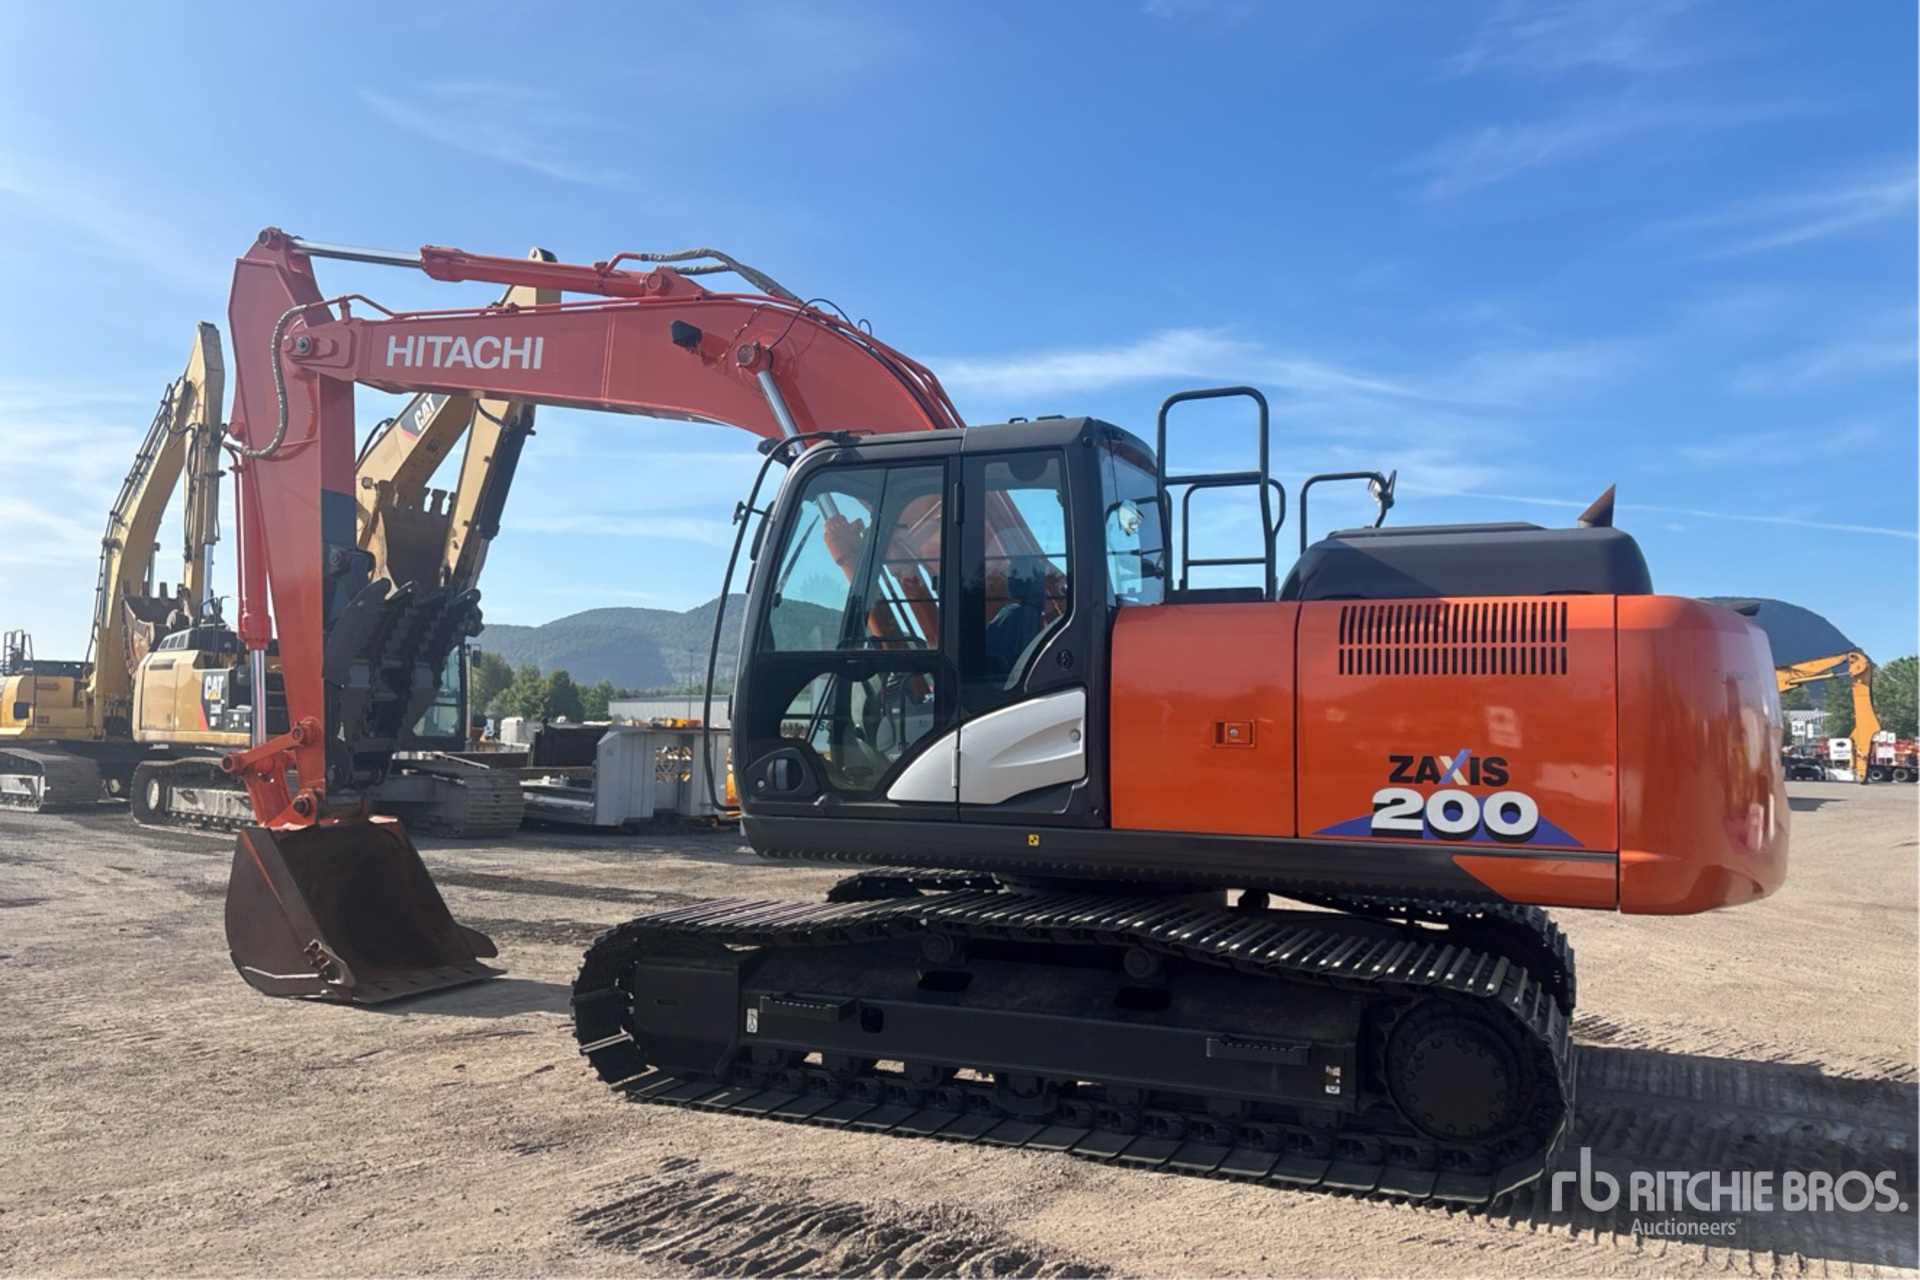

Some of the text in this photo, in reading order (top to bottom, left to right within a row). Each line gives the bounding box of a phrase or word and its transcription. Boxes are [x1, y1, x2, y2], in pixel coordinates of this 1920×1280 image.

[386, 335, 544, 370] HITACHI
[414, 393, 436, 431] CAT
[204, 675, 225, 701] CAT
[1389, 749, 1510, 787] ZAXIS
[1371, 788, 1539, 842] 200
